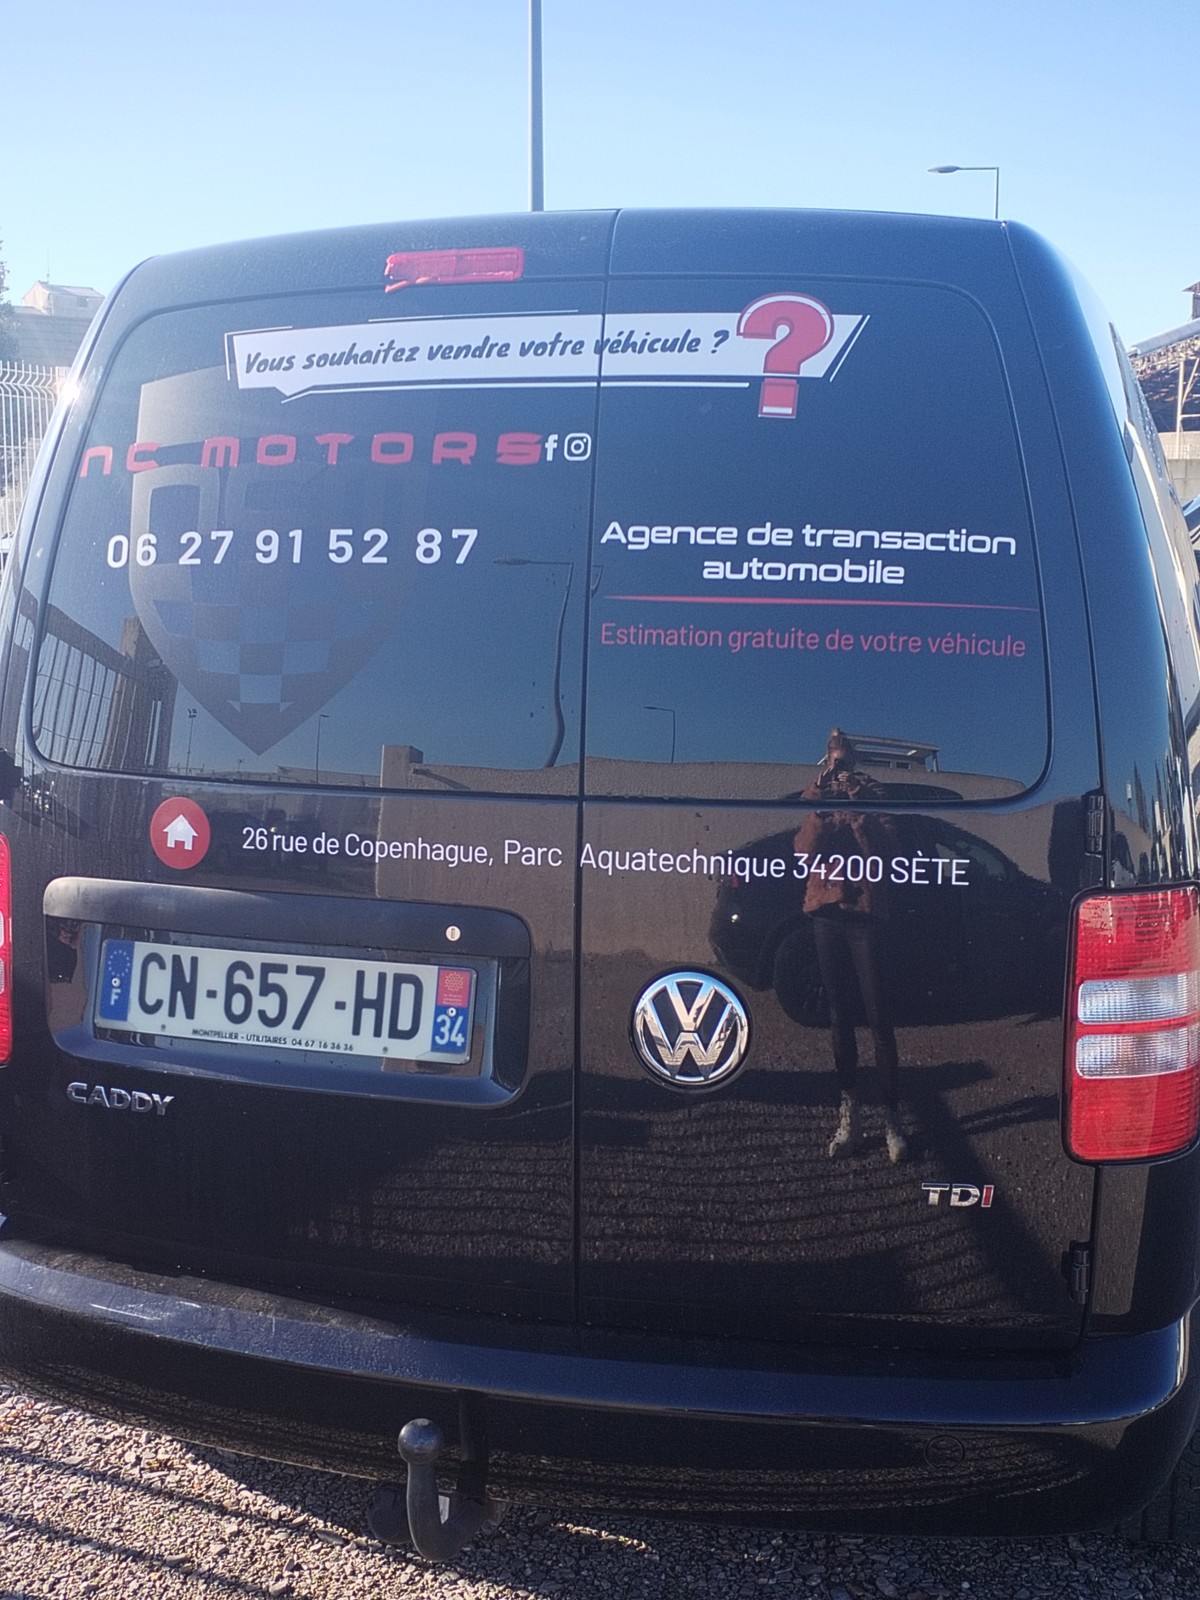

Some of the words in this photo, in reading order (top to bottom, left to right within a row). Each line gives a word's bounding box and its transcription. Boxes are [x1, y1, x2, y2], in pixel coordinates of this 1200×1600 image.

[245, 351, 296, 375] Vous
[303, 341, 418, 371] souhaitez
[427, 335, 510, 361] vendre
[519, 331, 585, 357] votre
[593, 327, 701, 356] véhicule
[710, 328, 730, 354] ?
[107, 533, 157, 568] 06
[179, 531, 234, 565] 27
[255, 530, 302, 564] 91
[328, 529, 388, 564] 52
[415, 529, 478, 565] 87
[600, 521, 738, 550] Agence
[747, 522, 794, 547] de
[802, 524, 1017, 556] transaction
[702, 557, 905, 585] automobile
[601, 622, 722, 647] Estimation
[728, 627, 819, 654] gratuite
[825, 628, 854, 651] de
[861, 632, 922, 653] votre
[928, 633, 1026, 658] véhicule
[242, 827, 268, 850] 26
[272, 834, 308, 853] rue
[312, 831, 339, 855] de
[344, 833, 495, 868] Copenhague,
[504, 839, 563, 867] Parc
[580, 843, 786, 883] Aquatechnique
[793, 853, 883, 883] 34200
[890, 850, 971, 886] SÈTE
[137, 951, 425, 1041] CN-657-HD
[192, 1028, 239, 1040] MONTPELLIER
[246, 1034, 288, 1046] UTILITAIRES
[434, 1013, 466, 1047] 34
[66, 1081, 175, 1117] CADDY
[921, 1182, 995, 1208] TDI
